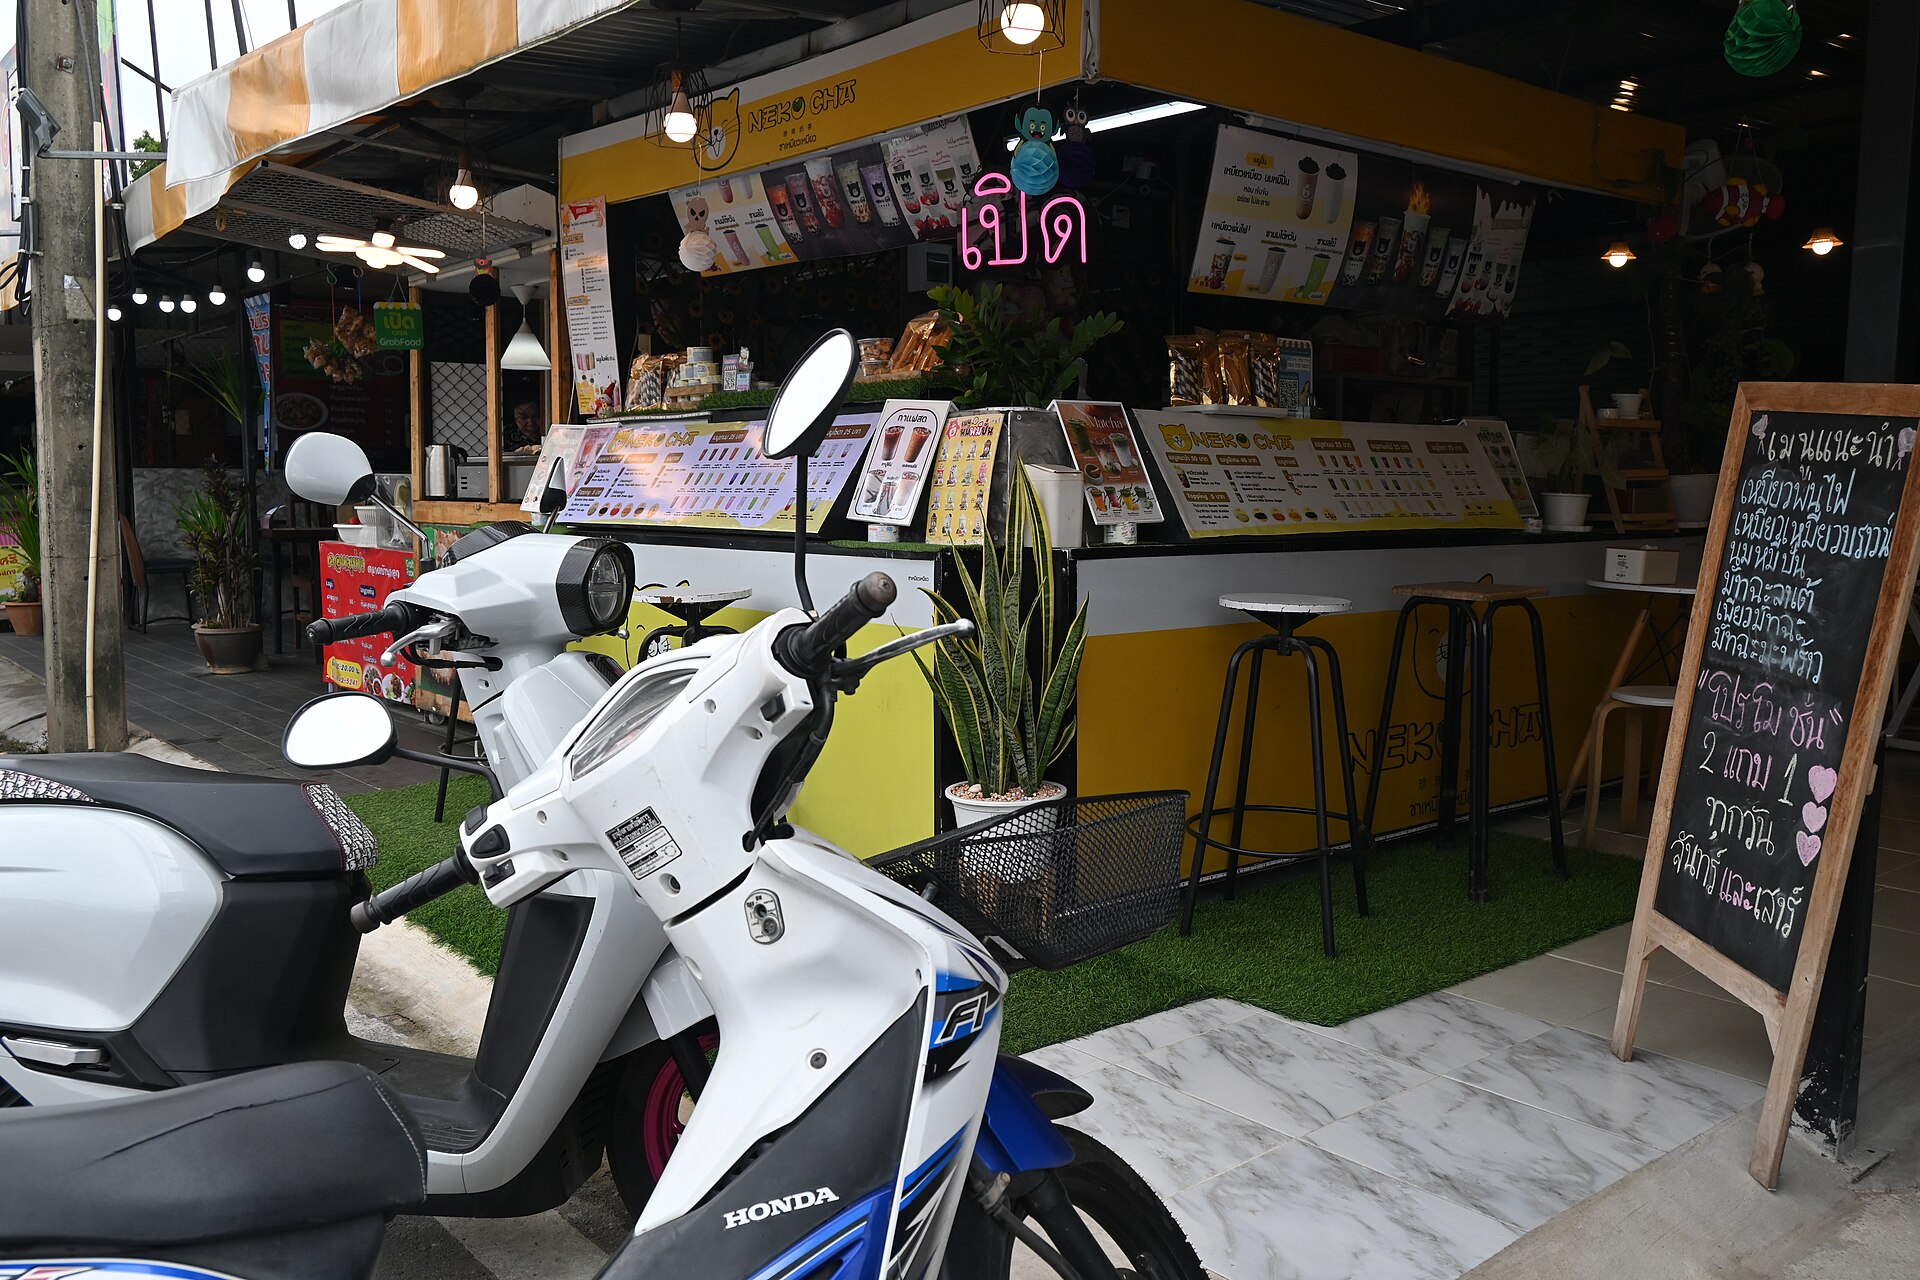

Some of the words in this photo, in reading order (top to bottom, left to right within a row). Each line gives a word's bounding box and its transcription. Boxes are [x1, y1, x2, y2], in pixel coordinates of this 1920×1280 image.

[748, 96, 805, 133] NEKO
[809, 79, 857, 115] CHA
[1223, 164, 1263, 181] เหมียวเหมียว
[961, 172, 1087, 271] เปิด
[383, 312, 415, 329] เปิด
[379, 337, 422, 346] GrabFood
[897, 414, 928, 423] กาแฟสด
[1091, 416, 1124, 429] Matcha
[625, 432, 666, 450] NEKO
[665, 431, 699, 448] CHA
[1190, 431, 1250, 449] NEKO
[1253, 434, 1295, 450] CHA
[1766, 421, 1896, 481] เมนูแนะนำ
[1186, 492, 1208, 501] Topping
[1488, 702, 1544, 748] HA
[1699, 731, 1718, 773] 2
[1778, 753, 1799, 806] 1
[1706, 795, 1775, 856] ทุกวัน
[934, 991, 989, 1044] FI
[723, 1187, 840, 1229] HONDA
